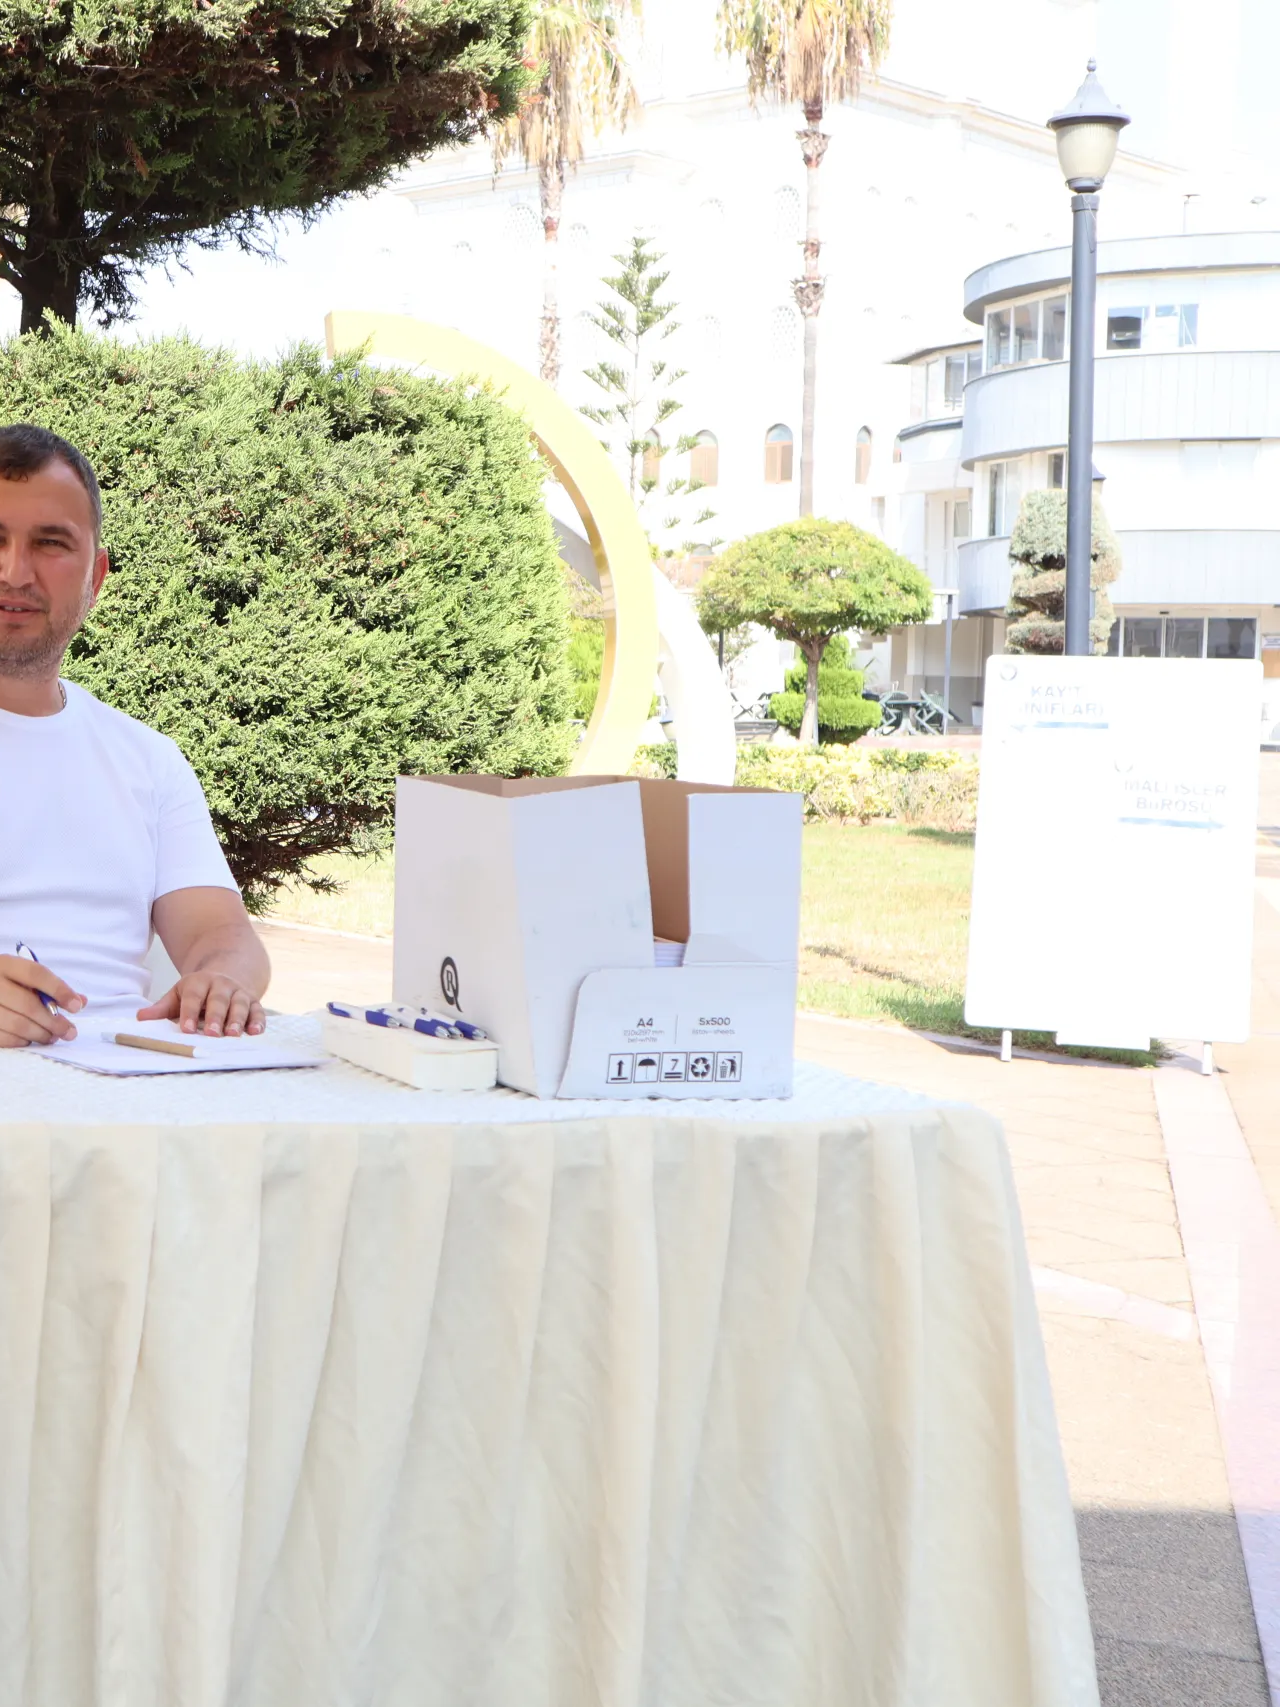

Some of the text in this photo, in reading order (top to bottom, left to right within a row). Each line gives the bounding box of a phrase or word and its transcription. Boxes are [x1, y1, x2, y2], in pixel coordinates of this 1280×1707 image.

[636, 1017, 654, 1028] A4
[699, 1017, 731, 1026] 5x500
[670, 1058, 679, 1071] 7
